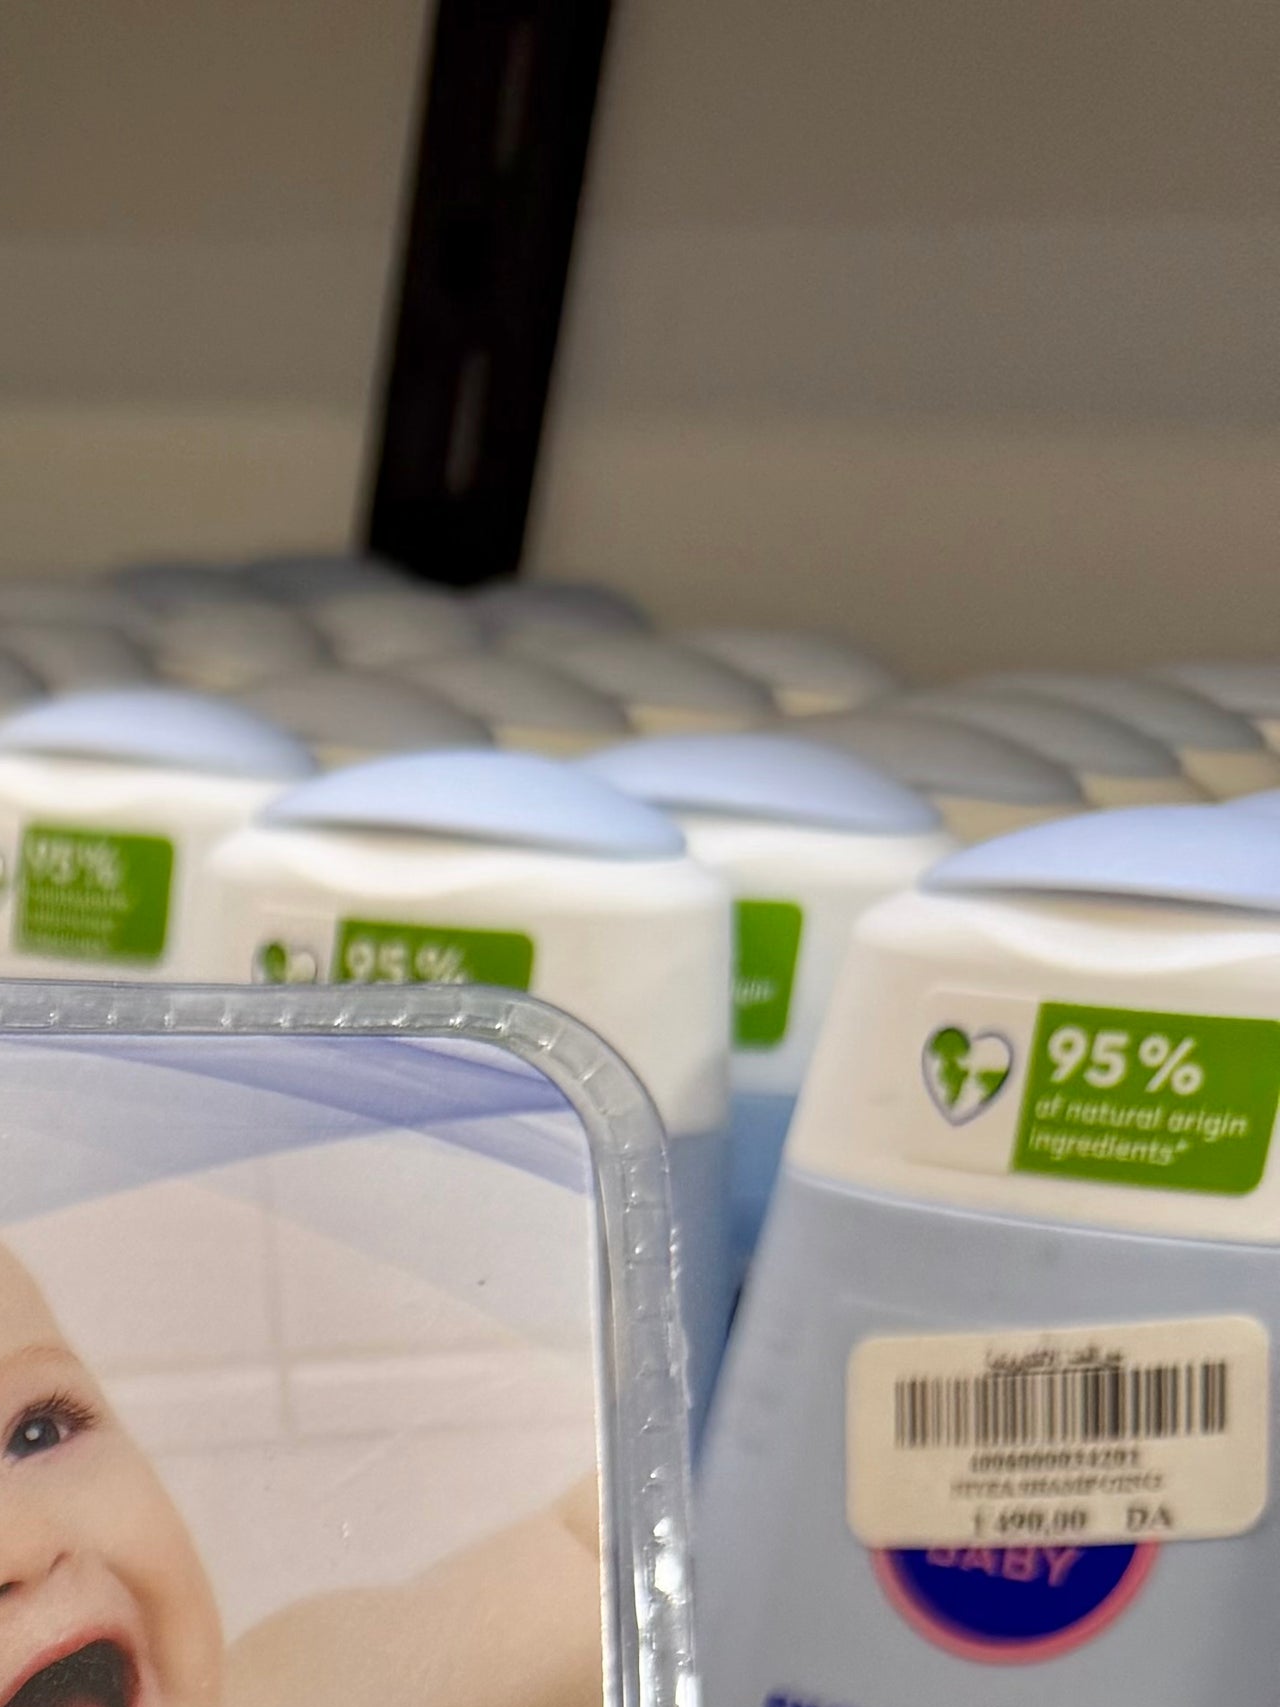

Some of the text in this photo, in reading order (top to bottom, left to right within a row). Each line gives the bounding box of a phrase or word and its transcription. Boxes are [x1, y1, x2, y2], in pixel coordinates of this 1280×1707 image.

[1034, 1096, 1248, 1142] of natural origin
[1126, 1506, 1173, 1530] DA
